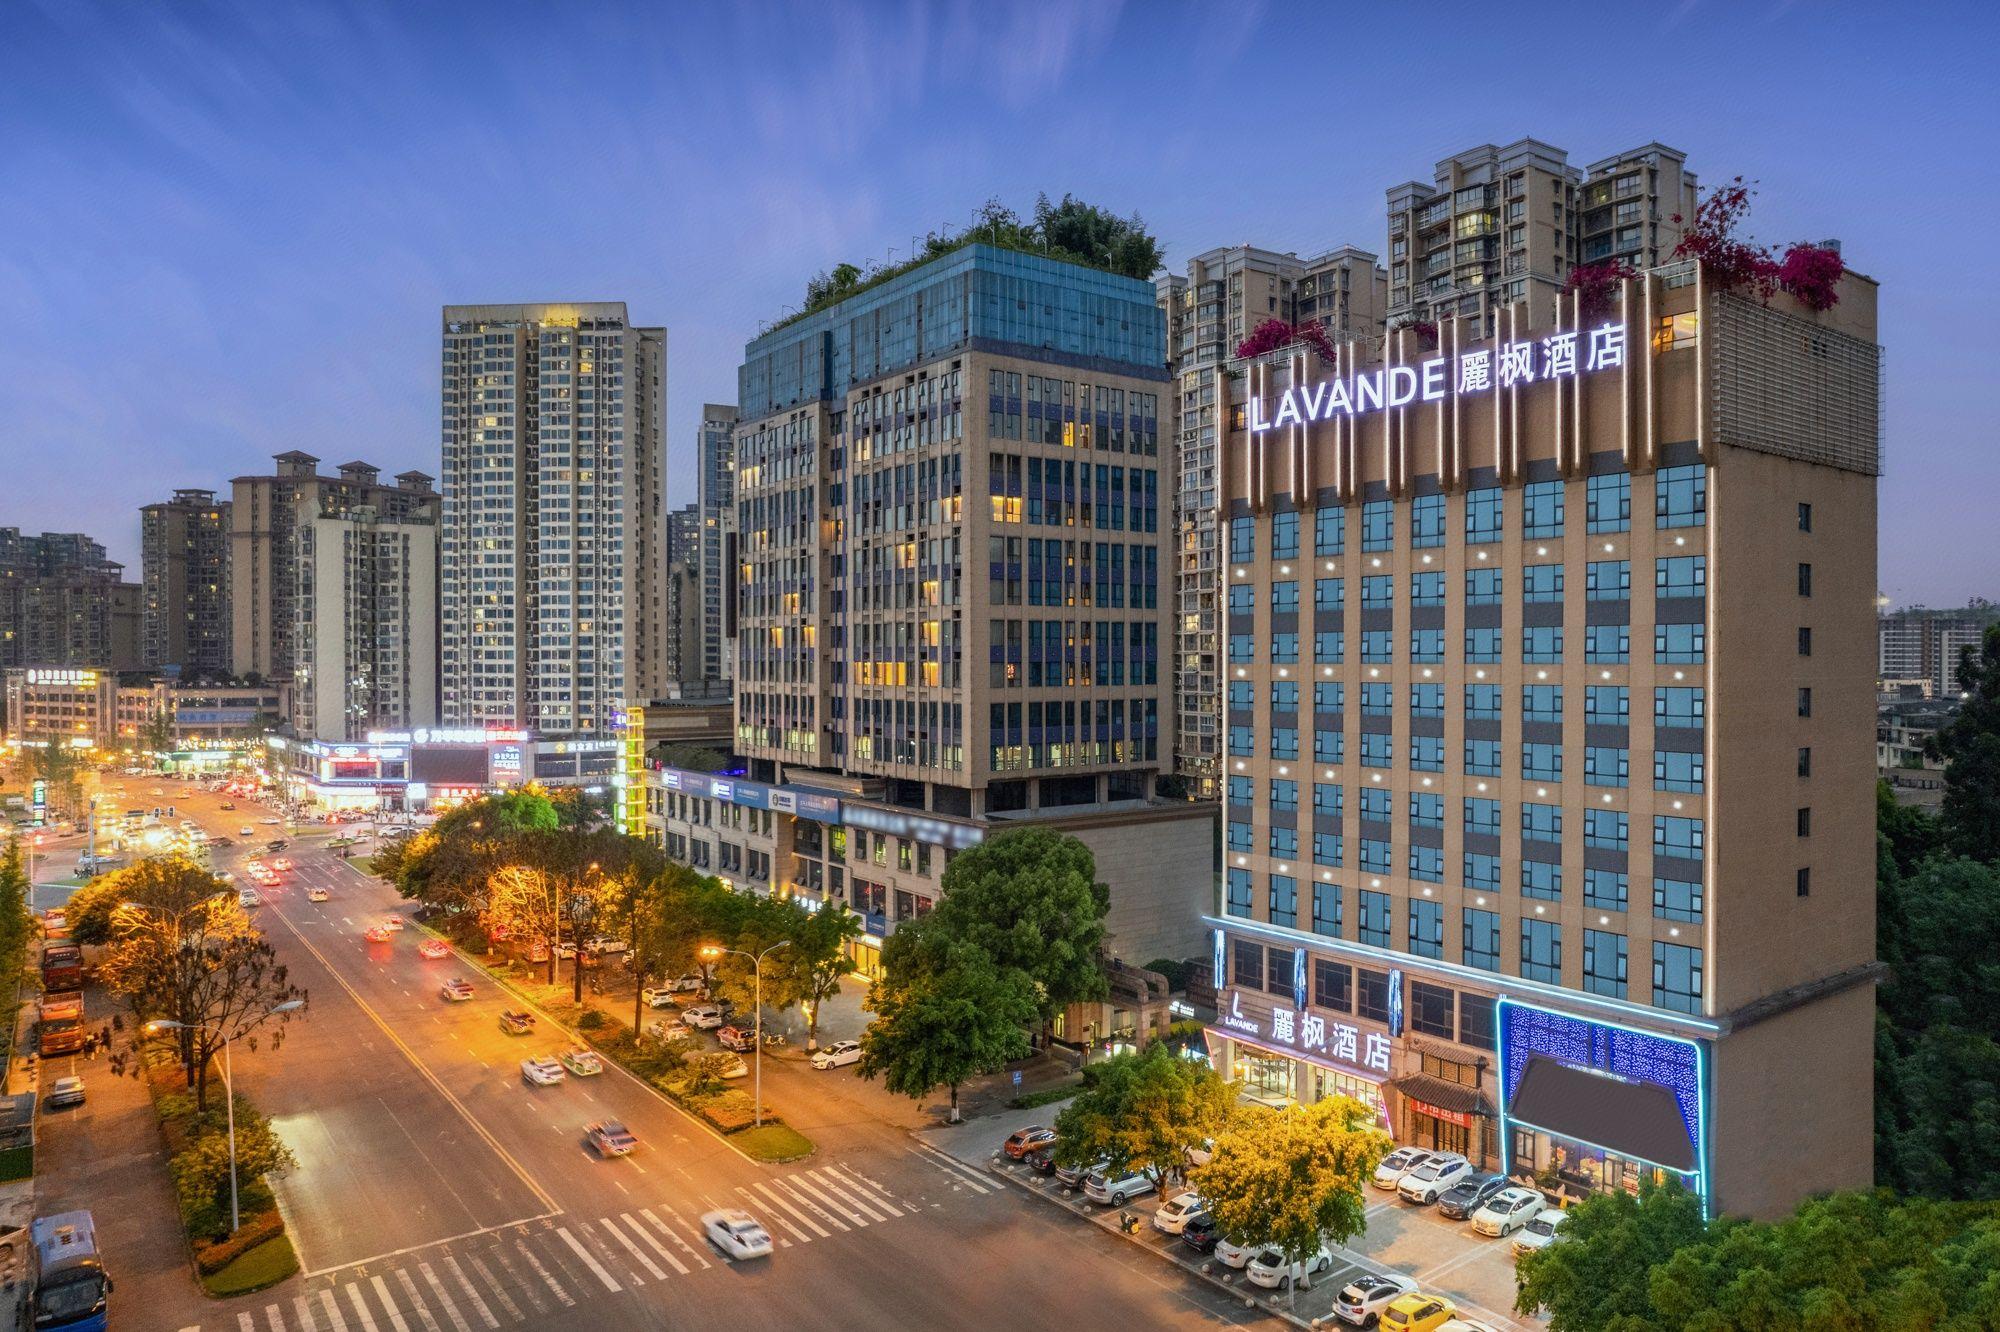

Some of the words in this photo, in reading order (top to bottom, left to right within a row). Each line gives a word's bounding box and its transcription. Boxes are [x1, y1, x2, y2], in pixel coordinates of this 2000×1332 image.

[1251, 357, 1445, 432] LAVANDE
[1458, 323, 1625, 394] 麗枫酒店
[1225, 1015, 1259, 1033] LAVANDE
[1271, 1007, 1391, 1072] 麗枫酒店
